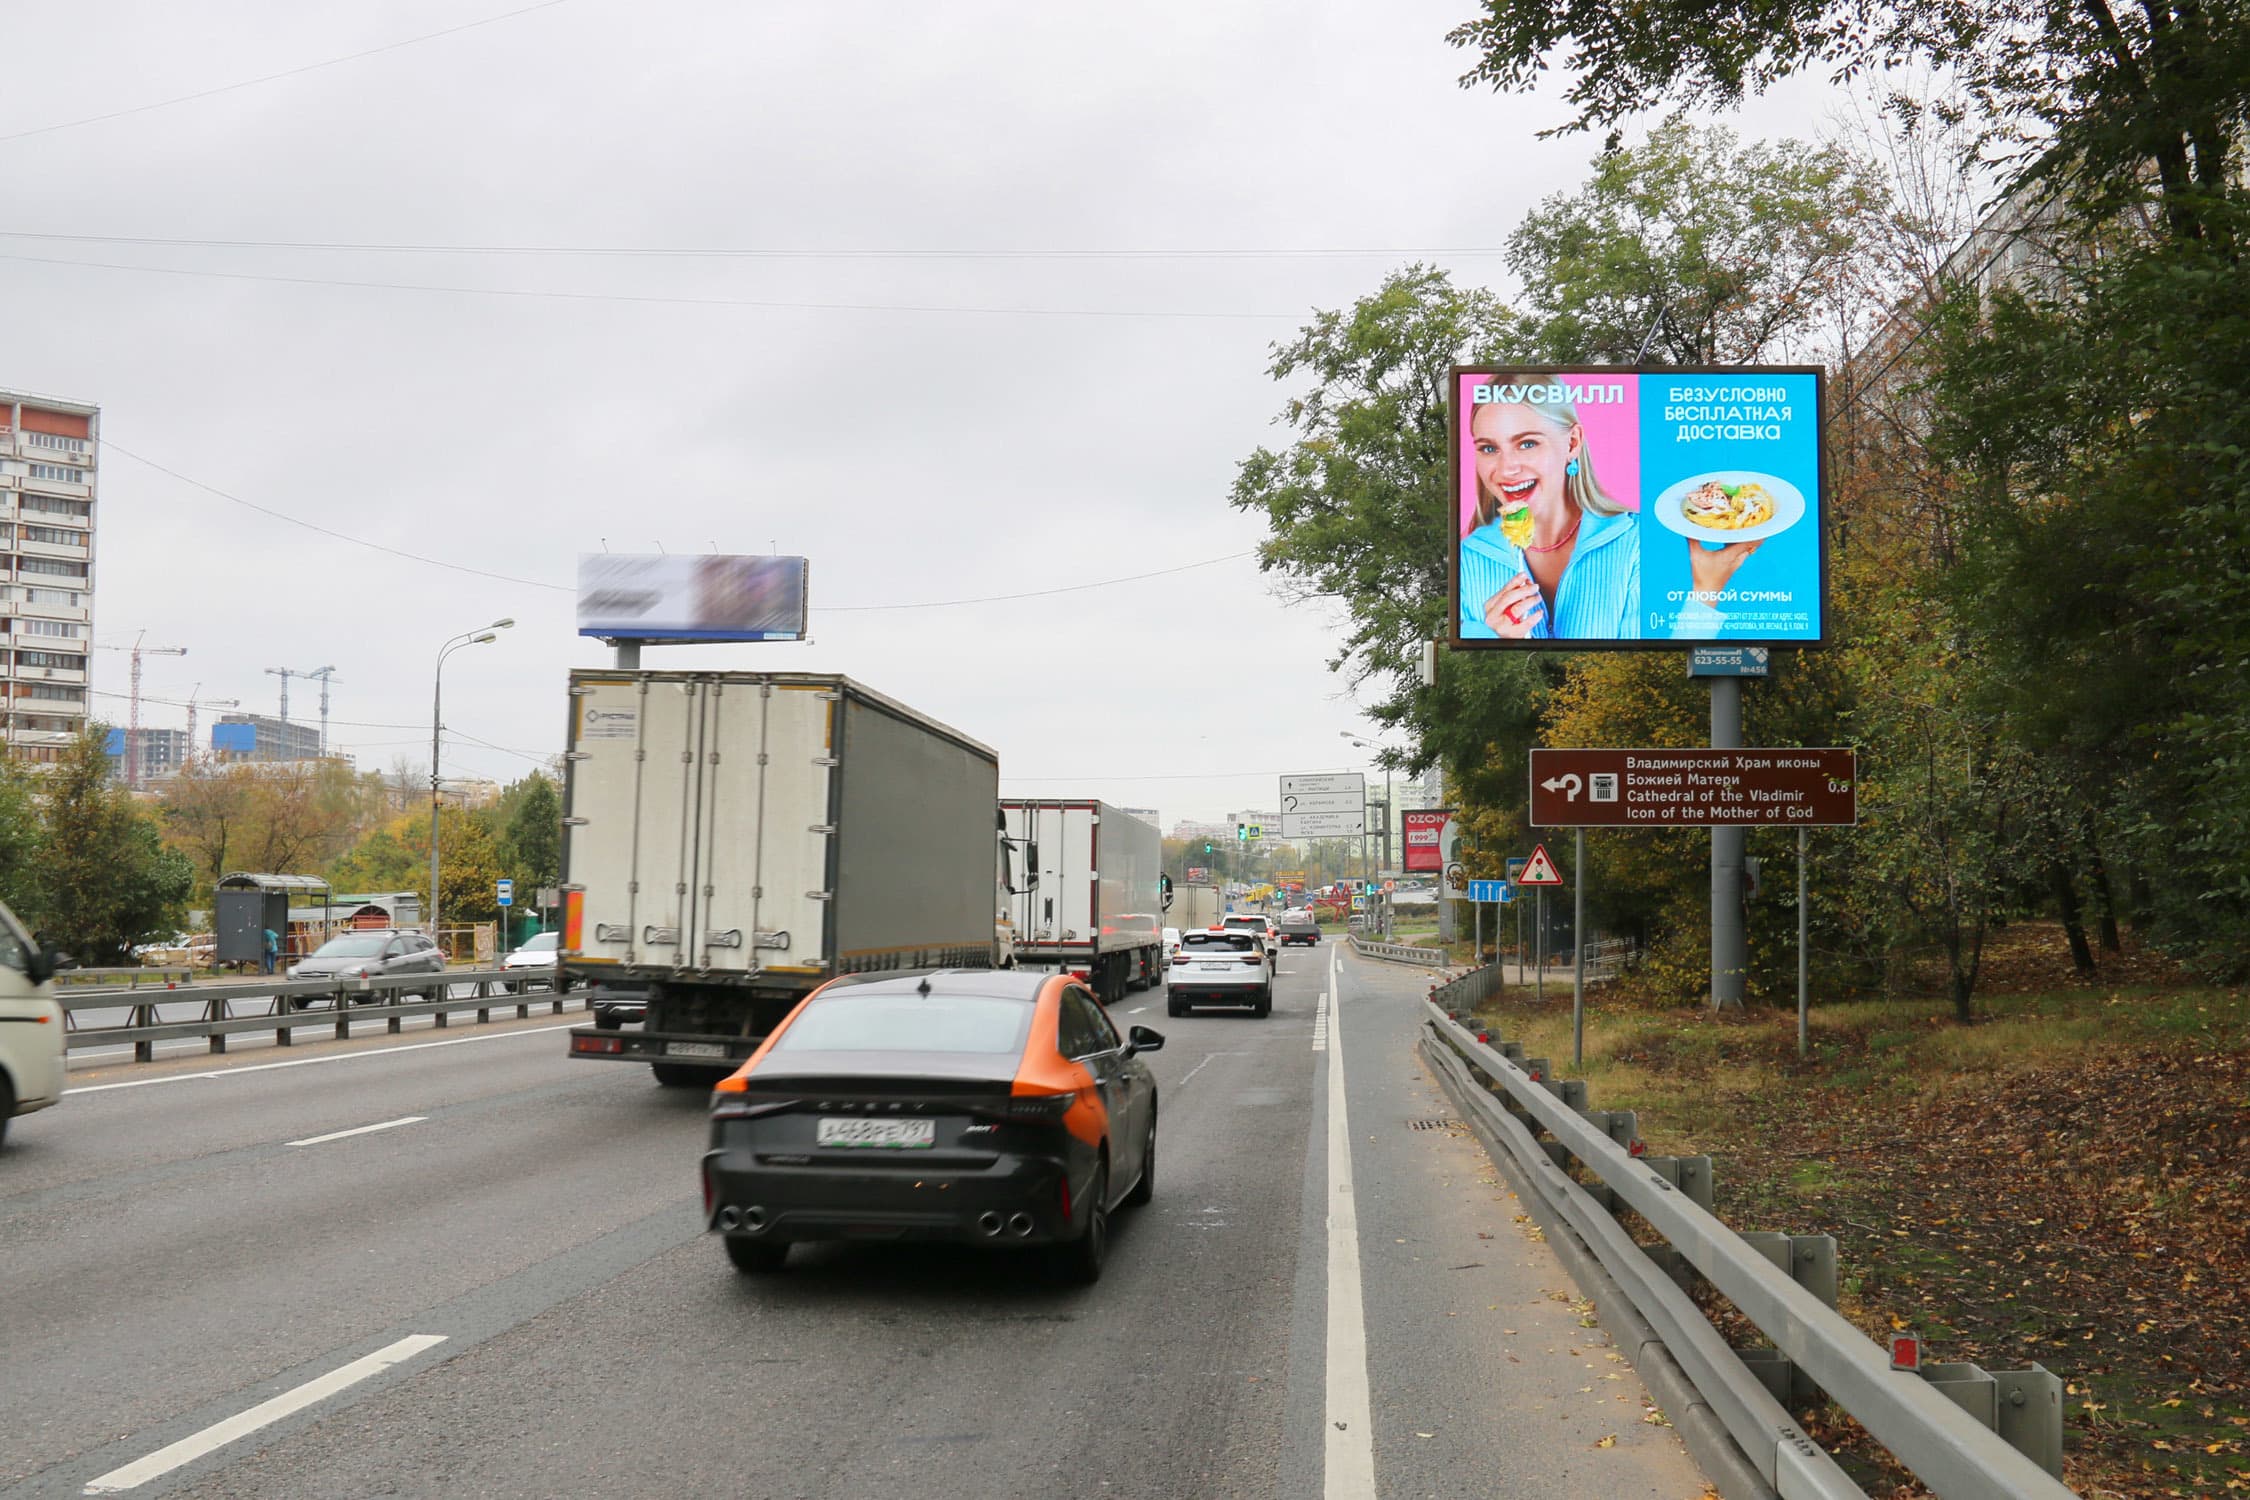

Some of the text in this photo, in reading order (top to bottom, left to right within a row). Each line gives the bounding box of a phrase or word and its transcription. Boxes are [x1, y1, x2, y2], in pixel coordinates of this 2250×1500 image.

[1472, 384, 1624, 404] ВКУСВИЛЛ
[1666, 588, 1793, 602] ОТ ЛЮБОЙ СУММЫ
[1649, 611, 1666, 630] 0+
[1694, 656, 1742, 665] 623-55-55
[1626, 756, 1821, 772] Владимирский Храм иконы
[1627, 772, 1740, 788] Божией Матери
[1627, 789, 1805, 802] Cathedral of the Vladimir
[1627, 805, 1814, 818] Icon of the Mother of God
[1408, 814, 1446, 824] OZON
